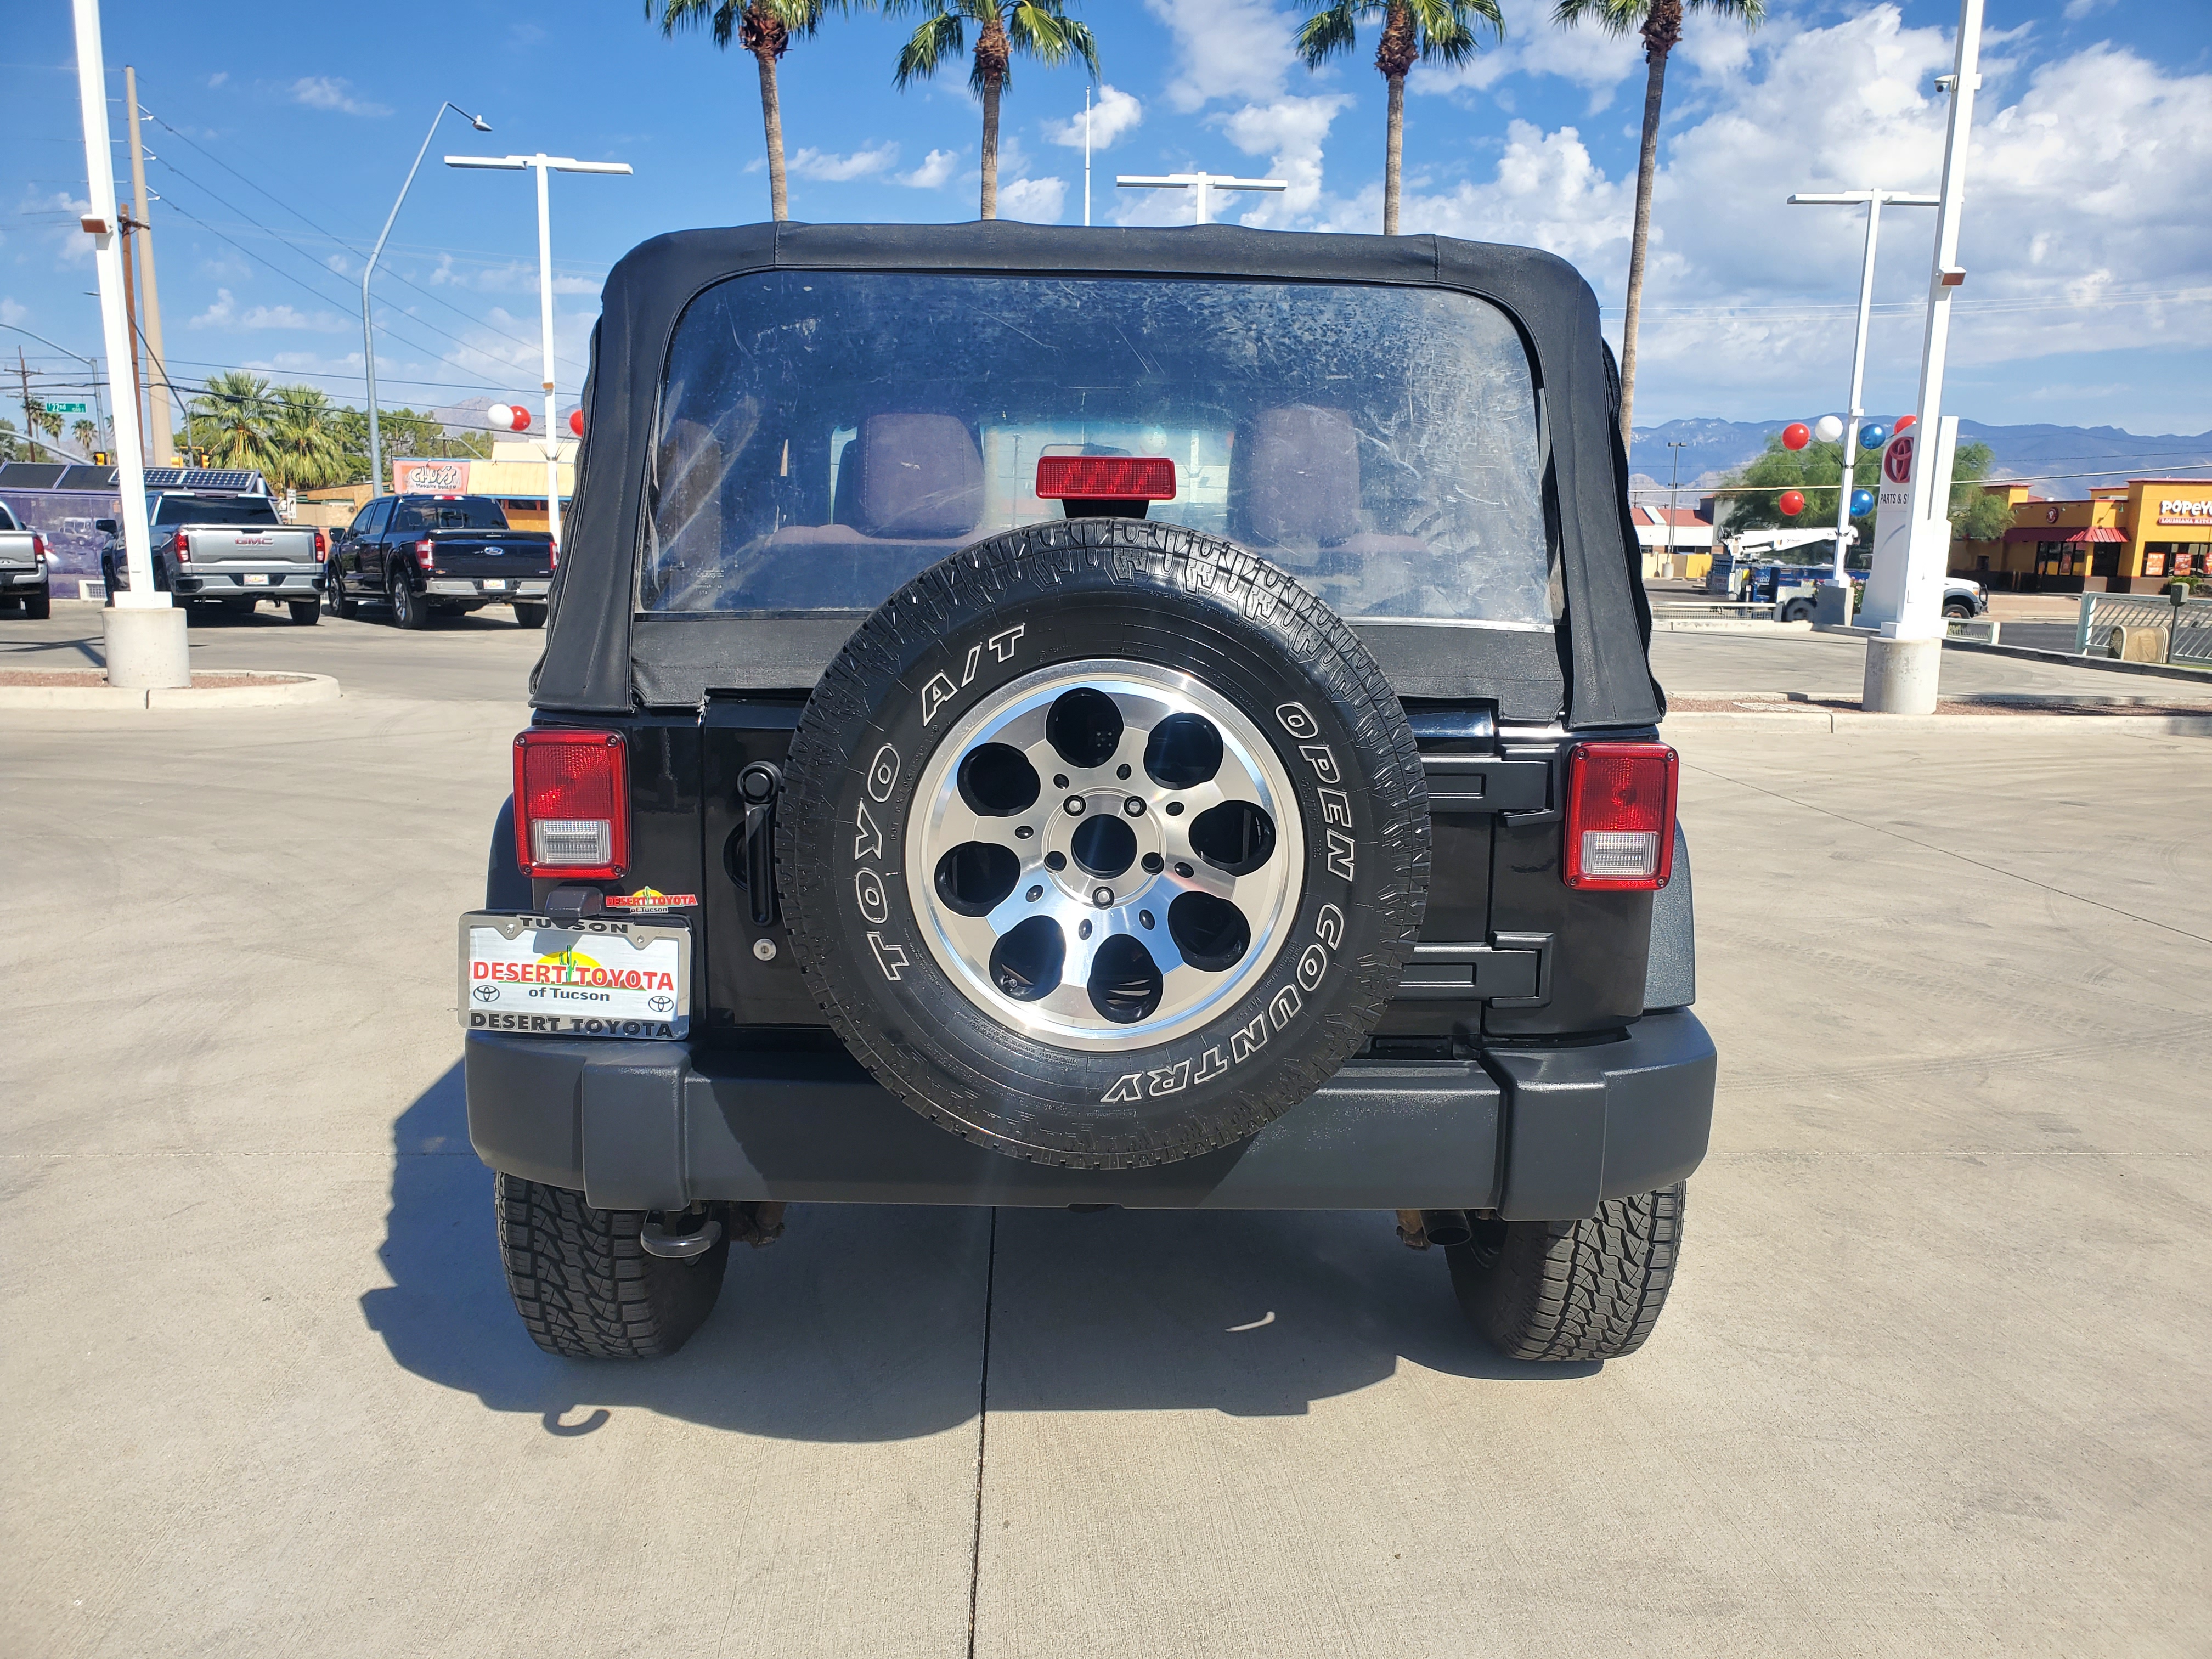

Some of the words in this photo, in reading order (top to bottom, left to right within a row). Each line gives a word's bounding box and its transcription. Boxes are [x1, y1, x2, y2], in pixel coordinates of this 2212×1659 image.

[52, 404, 66, 412] 22nd
[1880, 494, 1897, 504] PARTS
[1897, 493, 1901, 504] &
[1276, 702, 1355, 882] OPEN
[855, 744, 912, 982] TOYO
[922, 624, 1025, 727] A/T
[606, 896, 647, 906] DESERT
[650, 895, 697, 905] TOYOTA
[520, 917, 628, 934] TUSON
[473, 961, 567, 984] DESERT
[575, 967, 674, 991] TOYOTA
[529, 988, 546, 998] of
[550, 988, 610, 1001] Tucson
[1100, 903, 1344, 1103] COUNTRY
[470, 1012, 561, 1032] DESERT
[571, 1018, 674, 1037] TOYOTA
